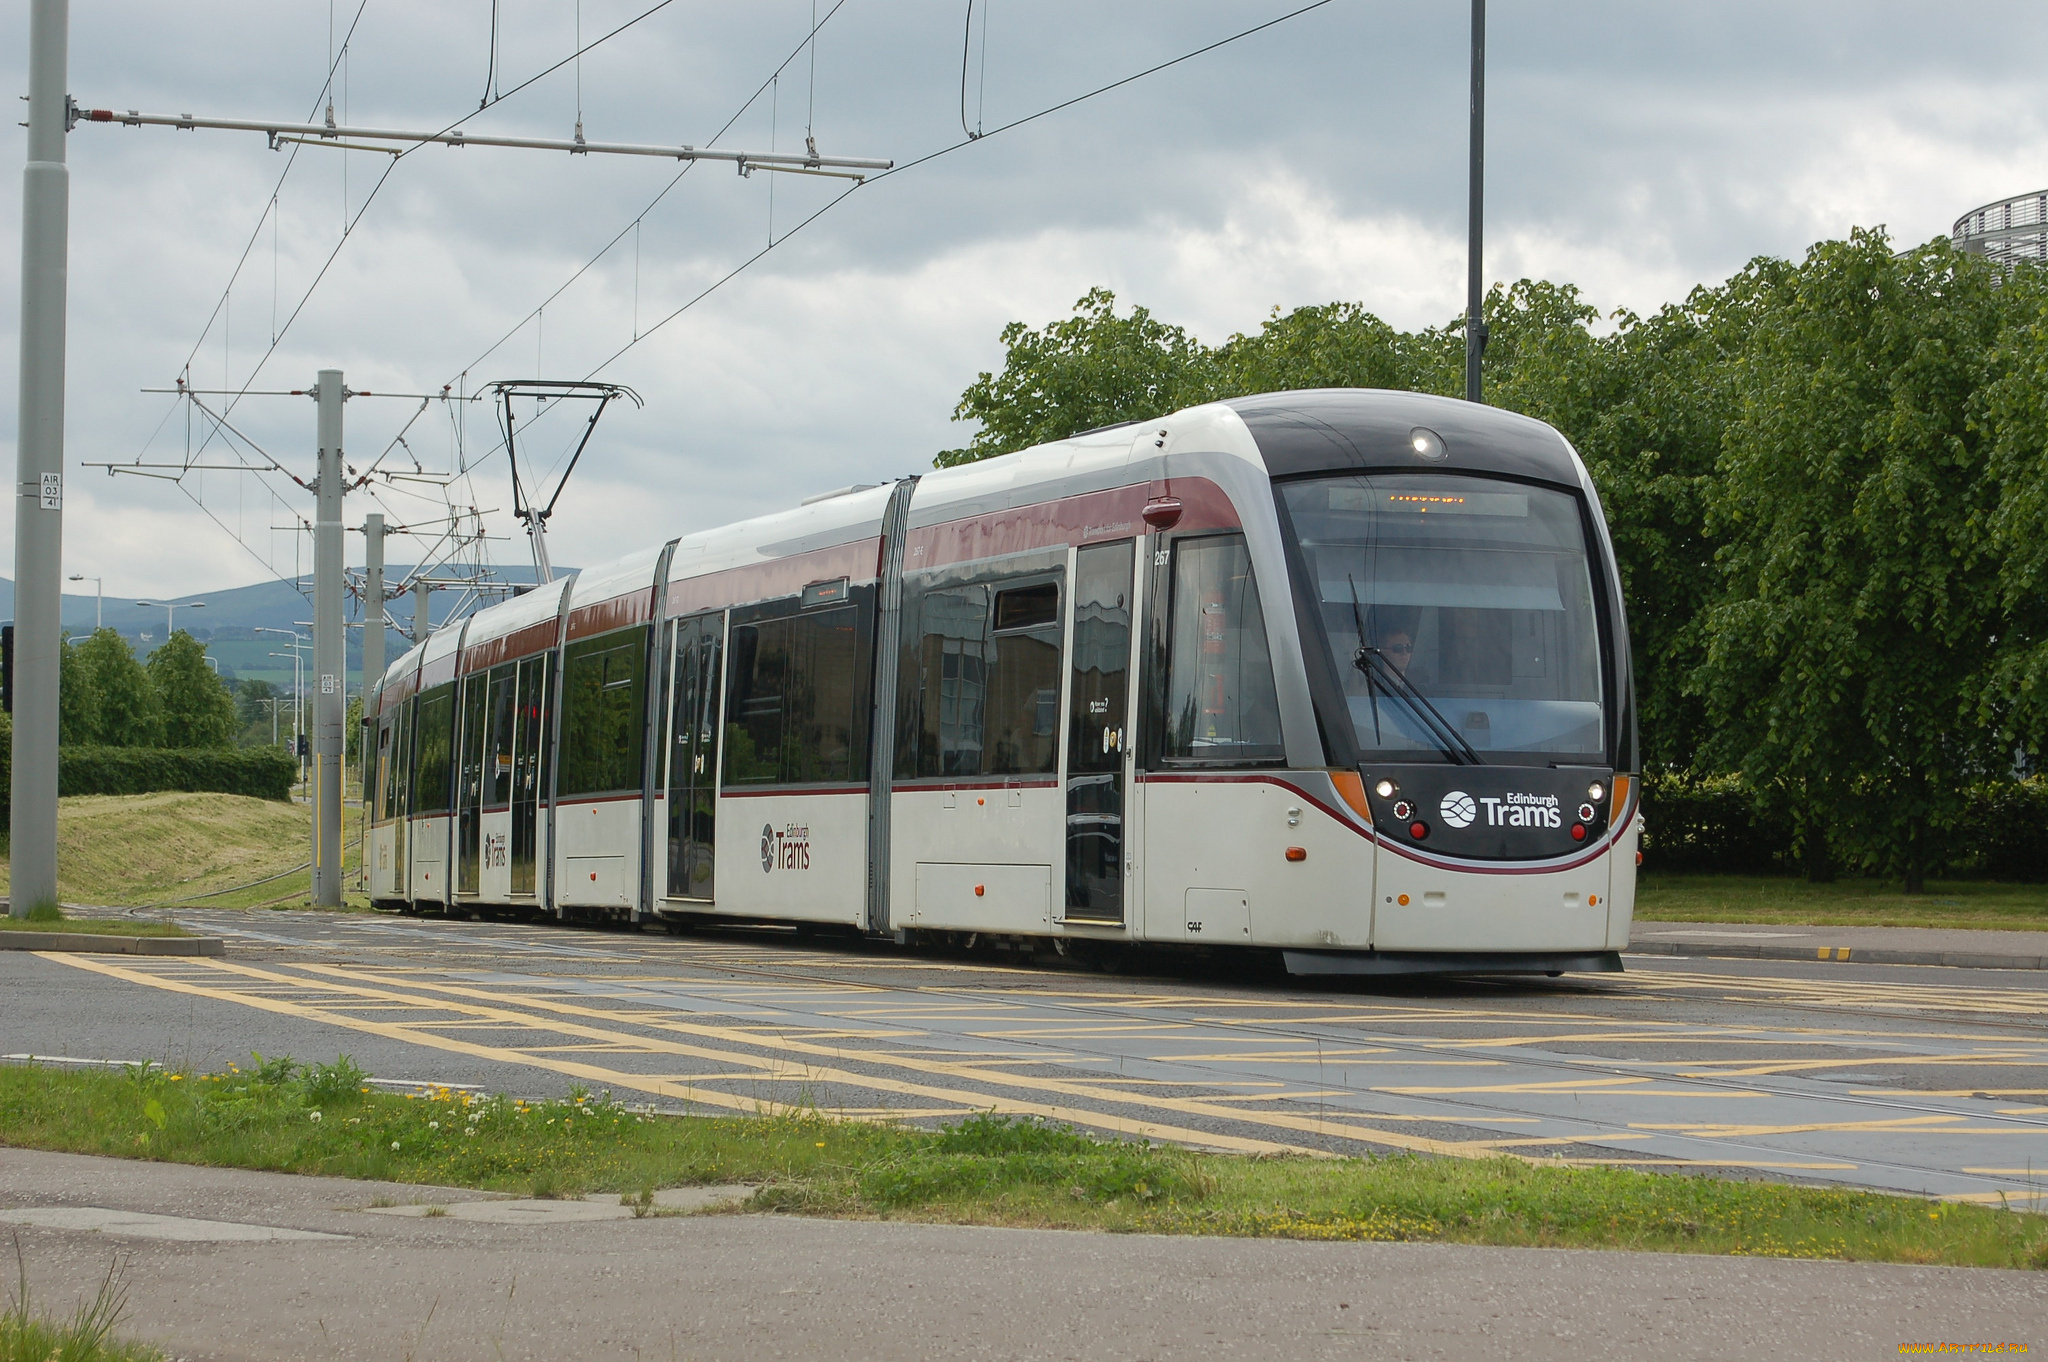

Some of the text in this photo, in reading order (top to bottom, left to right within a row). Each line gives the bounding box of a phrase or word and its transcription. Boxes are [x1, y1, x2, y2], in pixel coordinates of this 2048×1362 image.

[43, 475, 59, 484] AIR
[45, 487, 58, 495] 03
[47, 499, 56, 507] 41
[1155, 550, 1169, 566] 267
[1507, 792, 1558, 807] Edinburgh
[1480, 798, 1562, 828] Trams
[776, 831, 810, 870] Trams
